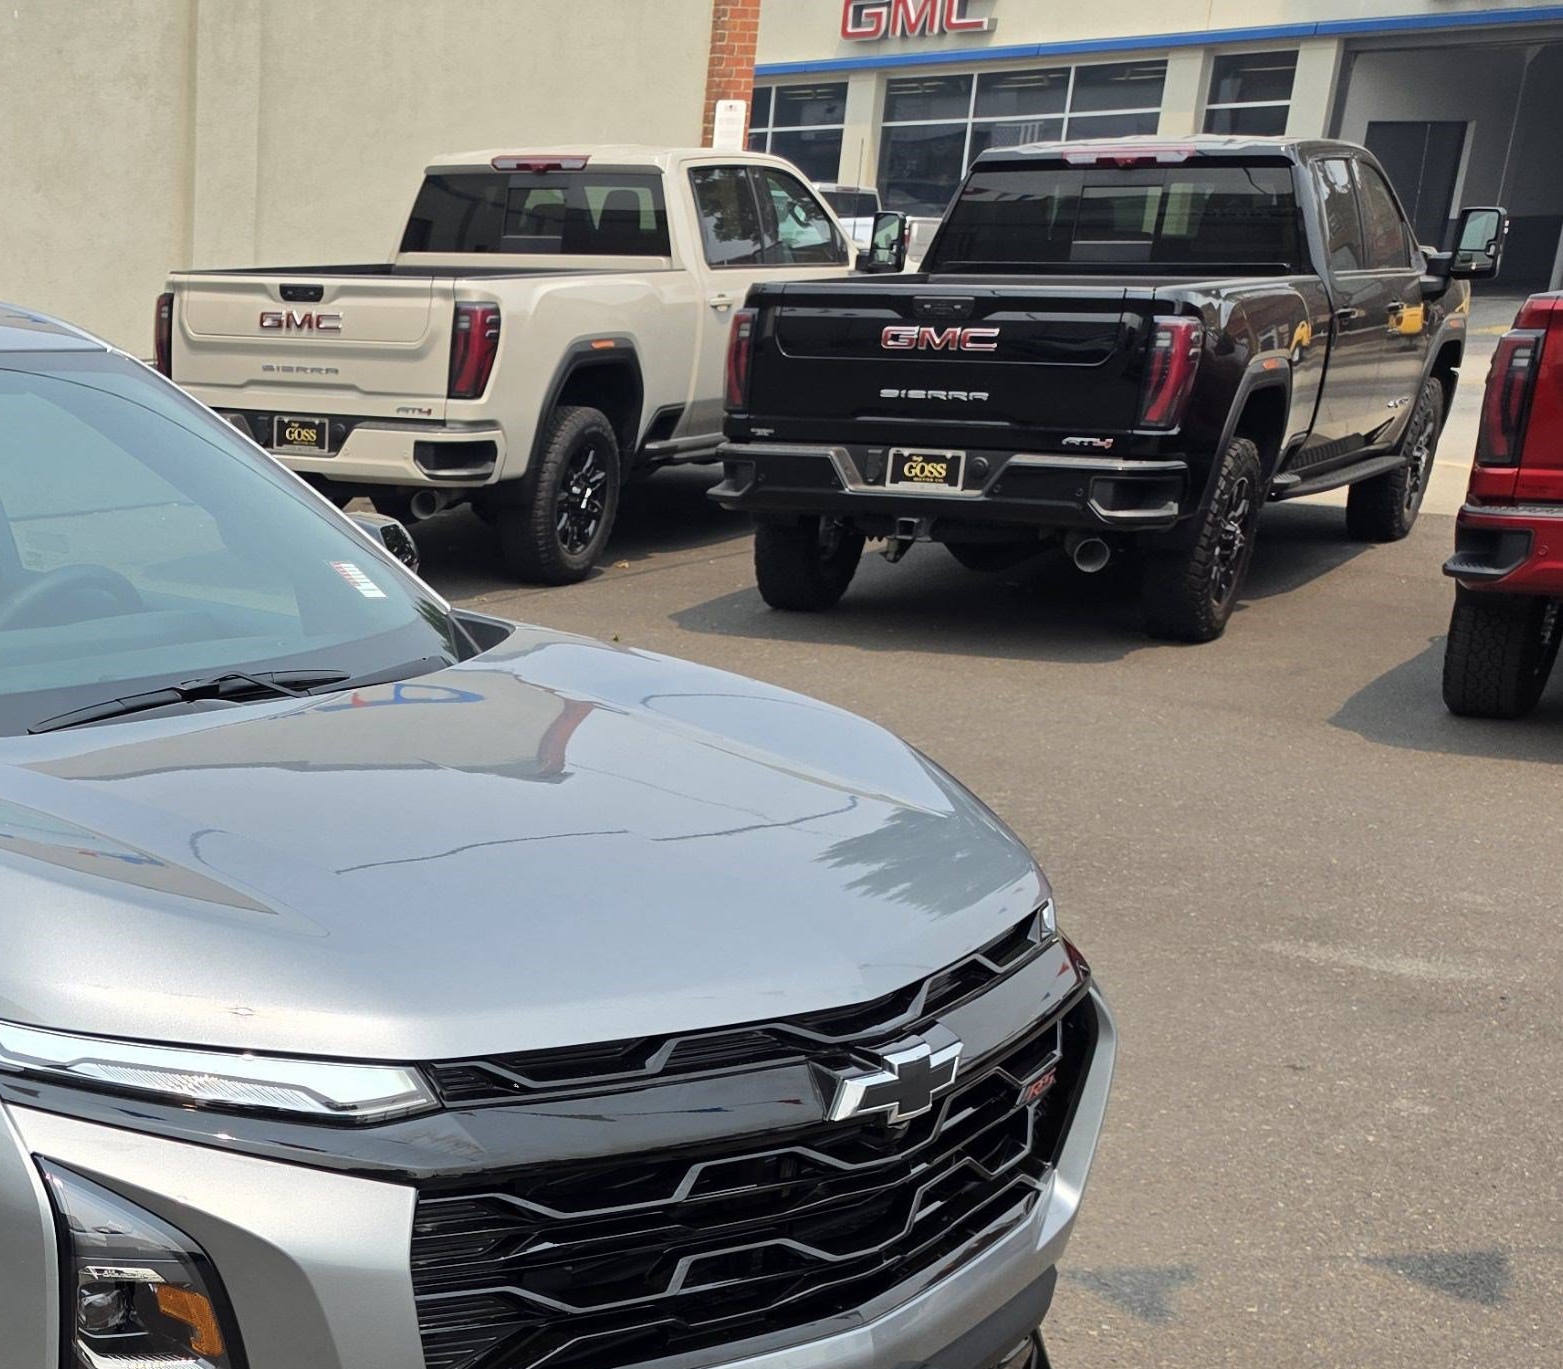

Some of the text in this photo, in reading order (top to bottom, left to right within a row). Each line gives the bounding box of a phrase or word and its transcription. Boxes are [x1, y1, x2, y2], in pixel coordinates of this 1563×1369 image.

[841, 0, 992, 41] GMC
[260, 311, 342, 332] GMC
[881, 326, 1000, 351] GMC
[262, 364, 339, 375] SIERRA
[880, 389, 989, 401] SIERRA
[396, 407, 432, 416] AT4
[285, 427, 317, 442] GOSS
[1061, 436, 1113, 449] AT4
[903, 461, 947, 478] GOSS
